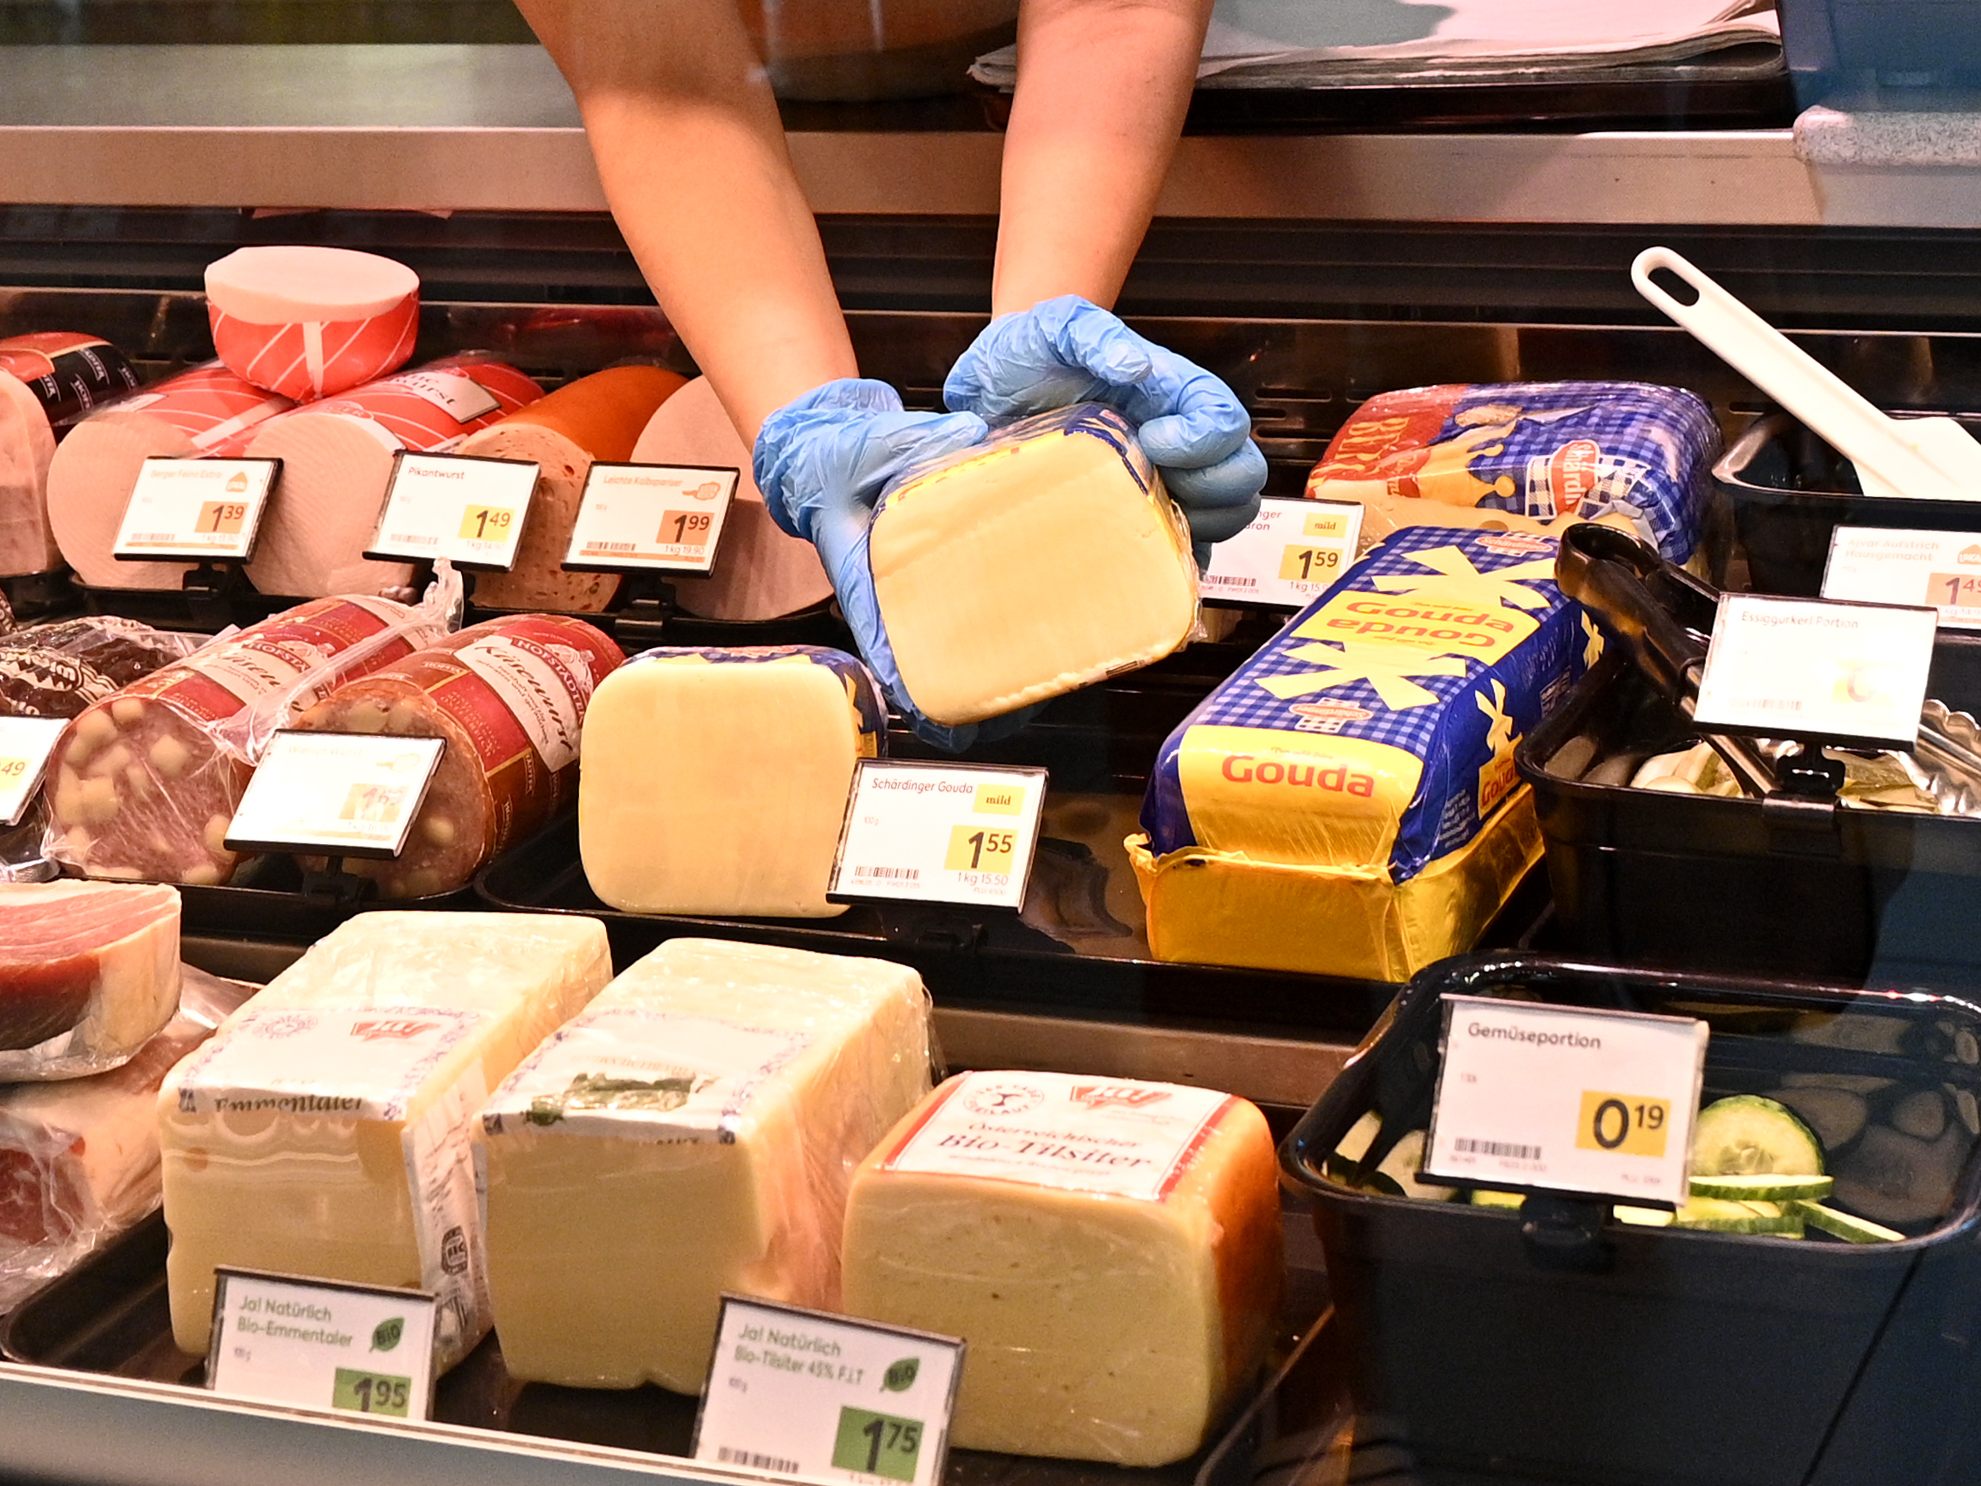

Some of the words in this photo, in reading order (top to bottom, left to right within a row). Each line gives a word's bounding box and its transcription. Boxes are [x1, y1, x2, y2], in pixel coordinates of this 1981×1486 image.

[408, 466, 465, 480] Pikantwurst
[1314, 521, 1337, 531] mild
[1295, 581, 1308, 592] kg
[1346, 601, 1515, 633] Gouda
[1816, 615, 1859, 629] Portion
[1326, 619, 1496, 647] Gouda
[474, 645, 573, 751] Käsewurst
[872, 777, 935, 794] Schärdinger
[938, 781, 973, 794] Gouda
[1221, 755, 1375, 798] Gouda
[985, 795, 1011, 806] mild
[964, 873, 978, 886] kg
[1468, 1022, 1602, 1050] Gemüseportion
[938, 1134, 1152, 1167] Bio-Tilsiter
[240, 1296, 262, 1311] Ja!
[265, 1298, 331, 1322] Natürlich
[237, 1316, 353, 1346] Bio-Emmentaler
[738, 1324, 762, 1341] Ja!
[768, 1328, 841, 1357] Natürlich
[808, 1362, 835, 1379] 45%
